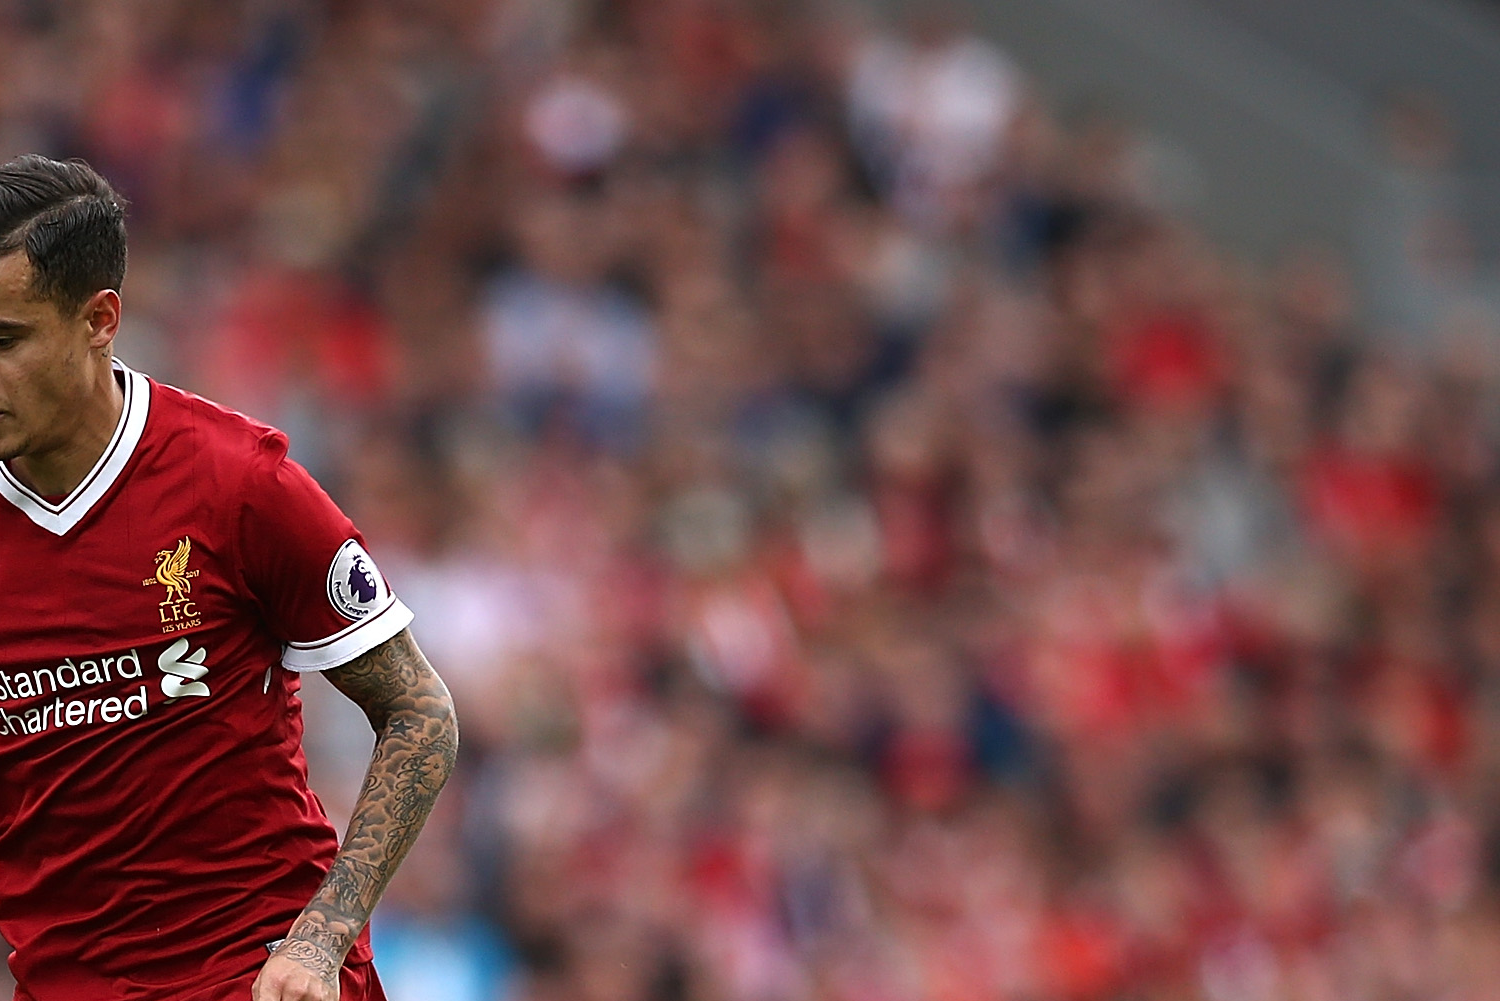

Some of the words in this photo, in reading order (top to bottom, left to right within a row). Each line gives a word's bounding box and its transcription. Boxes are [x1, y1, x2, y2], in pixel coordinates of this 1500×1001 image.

[159, 602, 202, 623] L.F.C.
[162, 625, 175, 633] 125
[175, 619, 202, 631] YEARS
